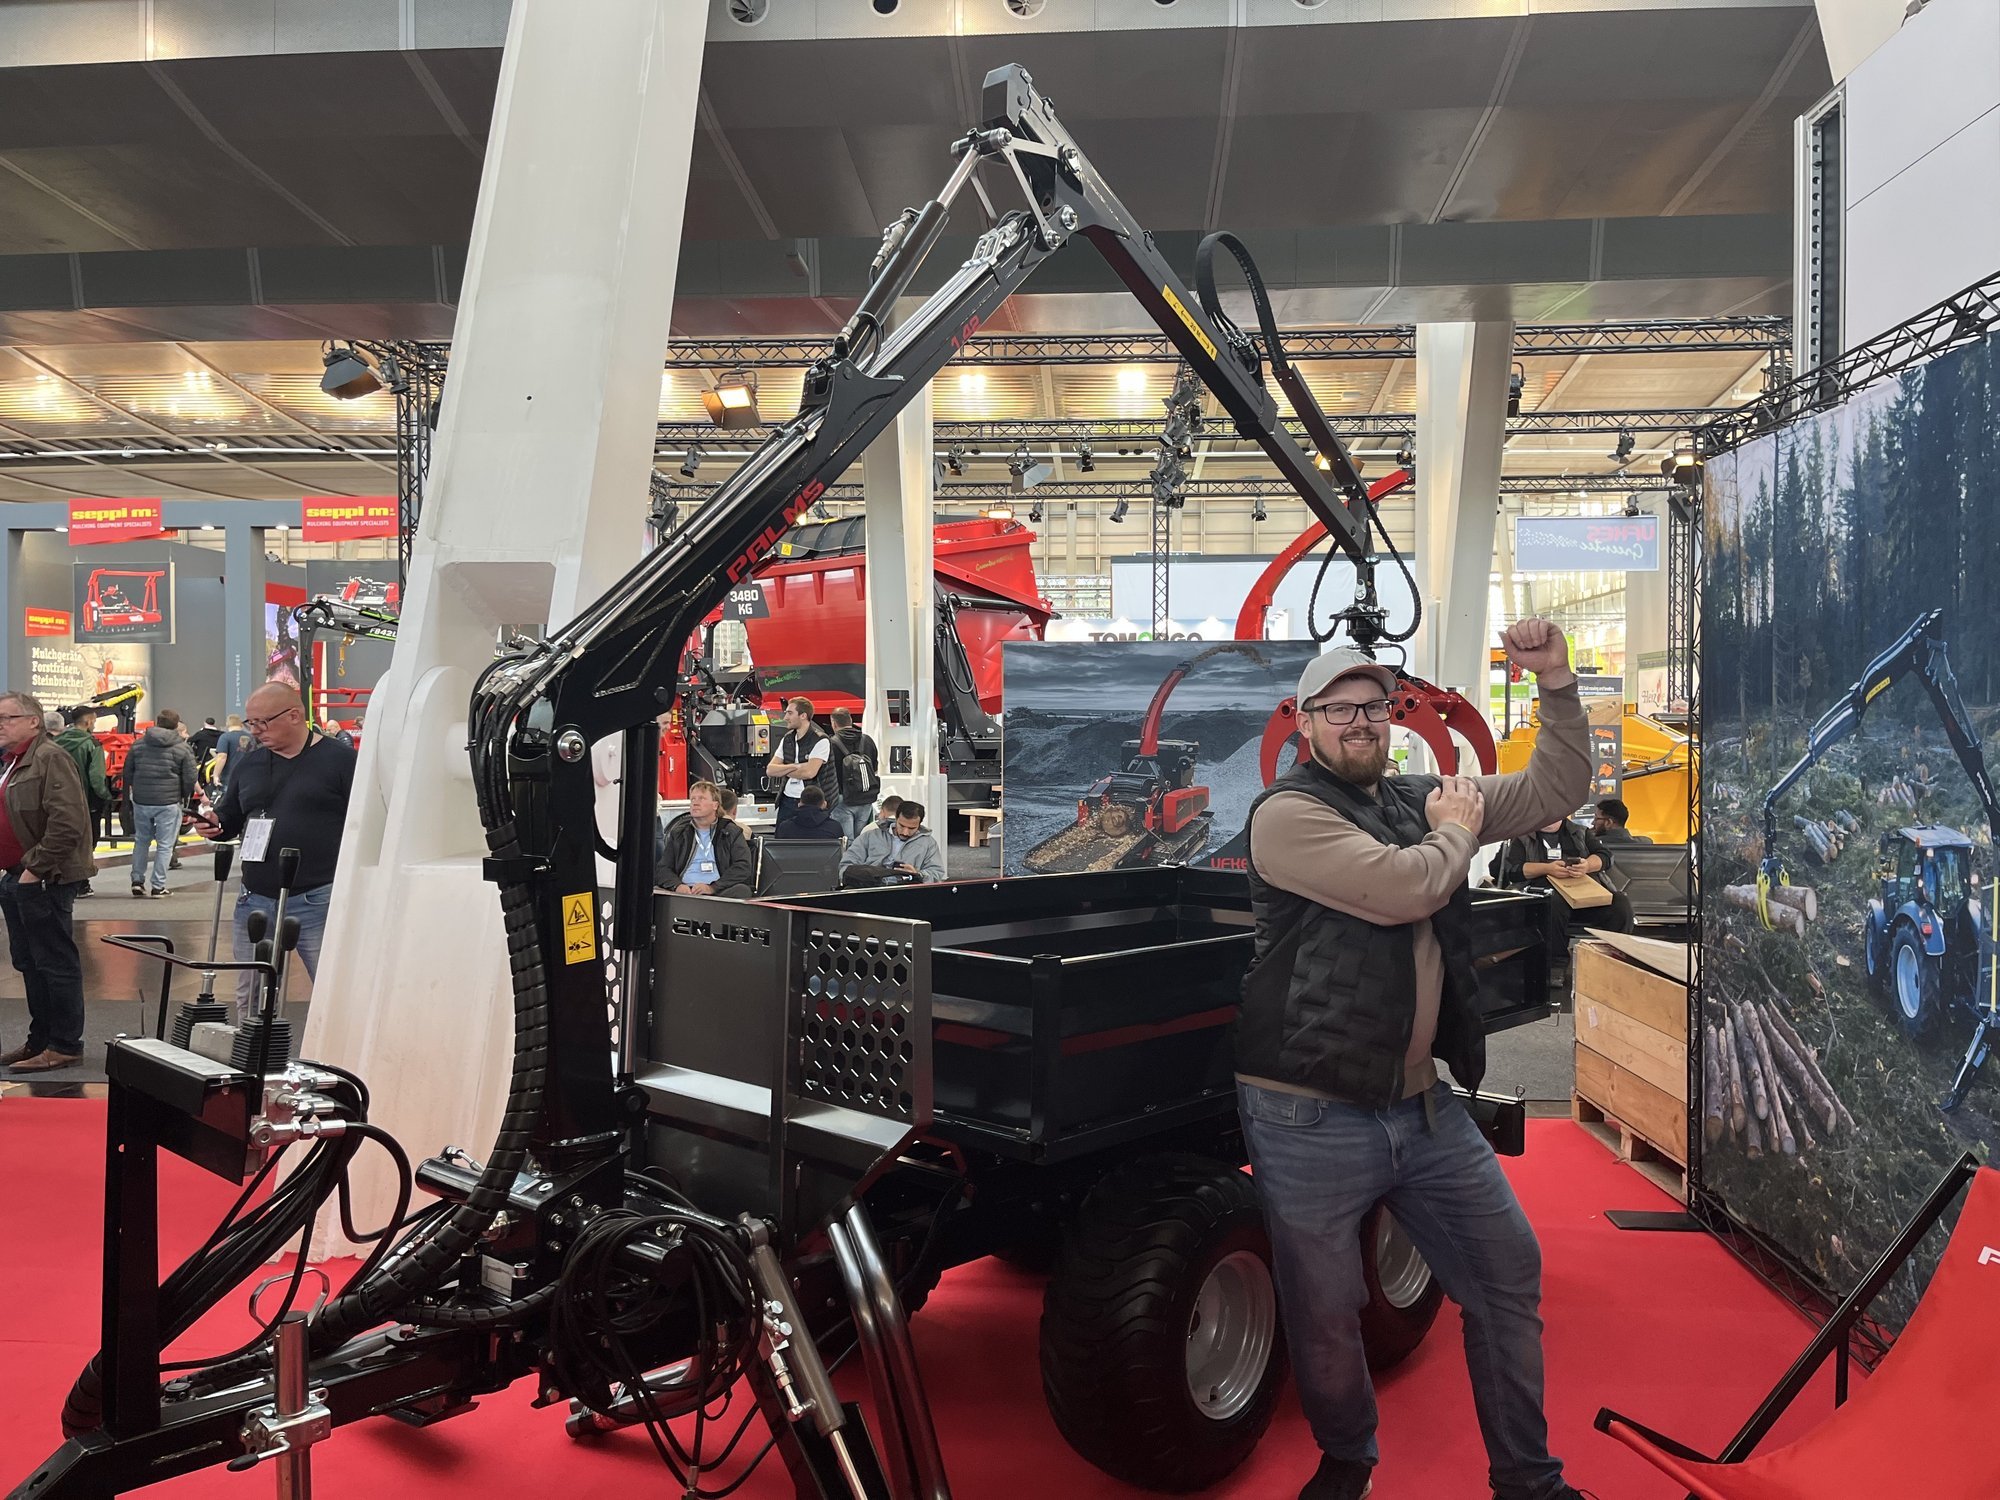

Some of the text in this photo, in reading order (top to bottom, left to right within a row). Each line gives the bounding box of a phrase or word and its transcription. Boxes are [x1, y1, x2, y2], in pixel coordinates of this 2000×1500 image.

[72, 508, 127, 521] seppi
[306, 506, 364, 519] seppi
[726, 477, 825, 584] PALMS
[730, 589, 759, 602] 3480
[738, 603, 753, 615] KG
[32, 661, 80, 676] Forstfräsen,
[32, 674, 84, 688] Steinbrecher
[1210, 857, 1247, 870] UFKE
